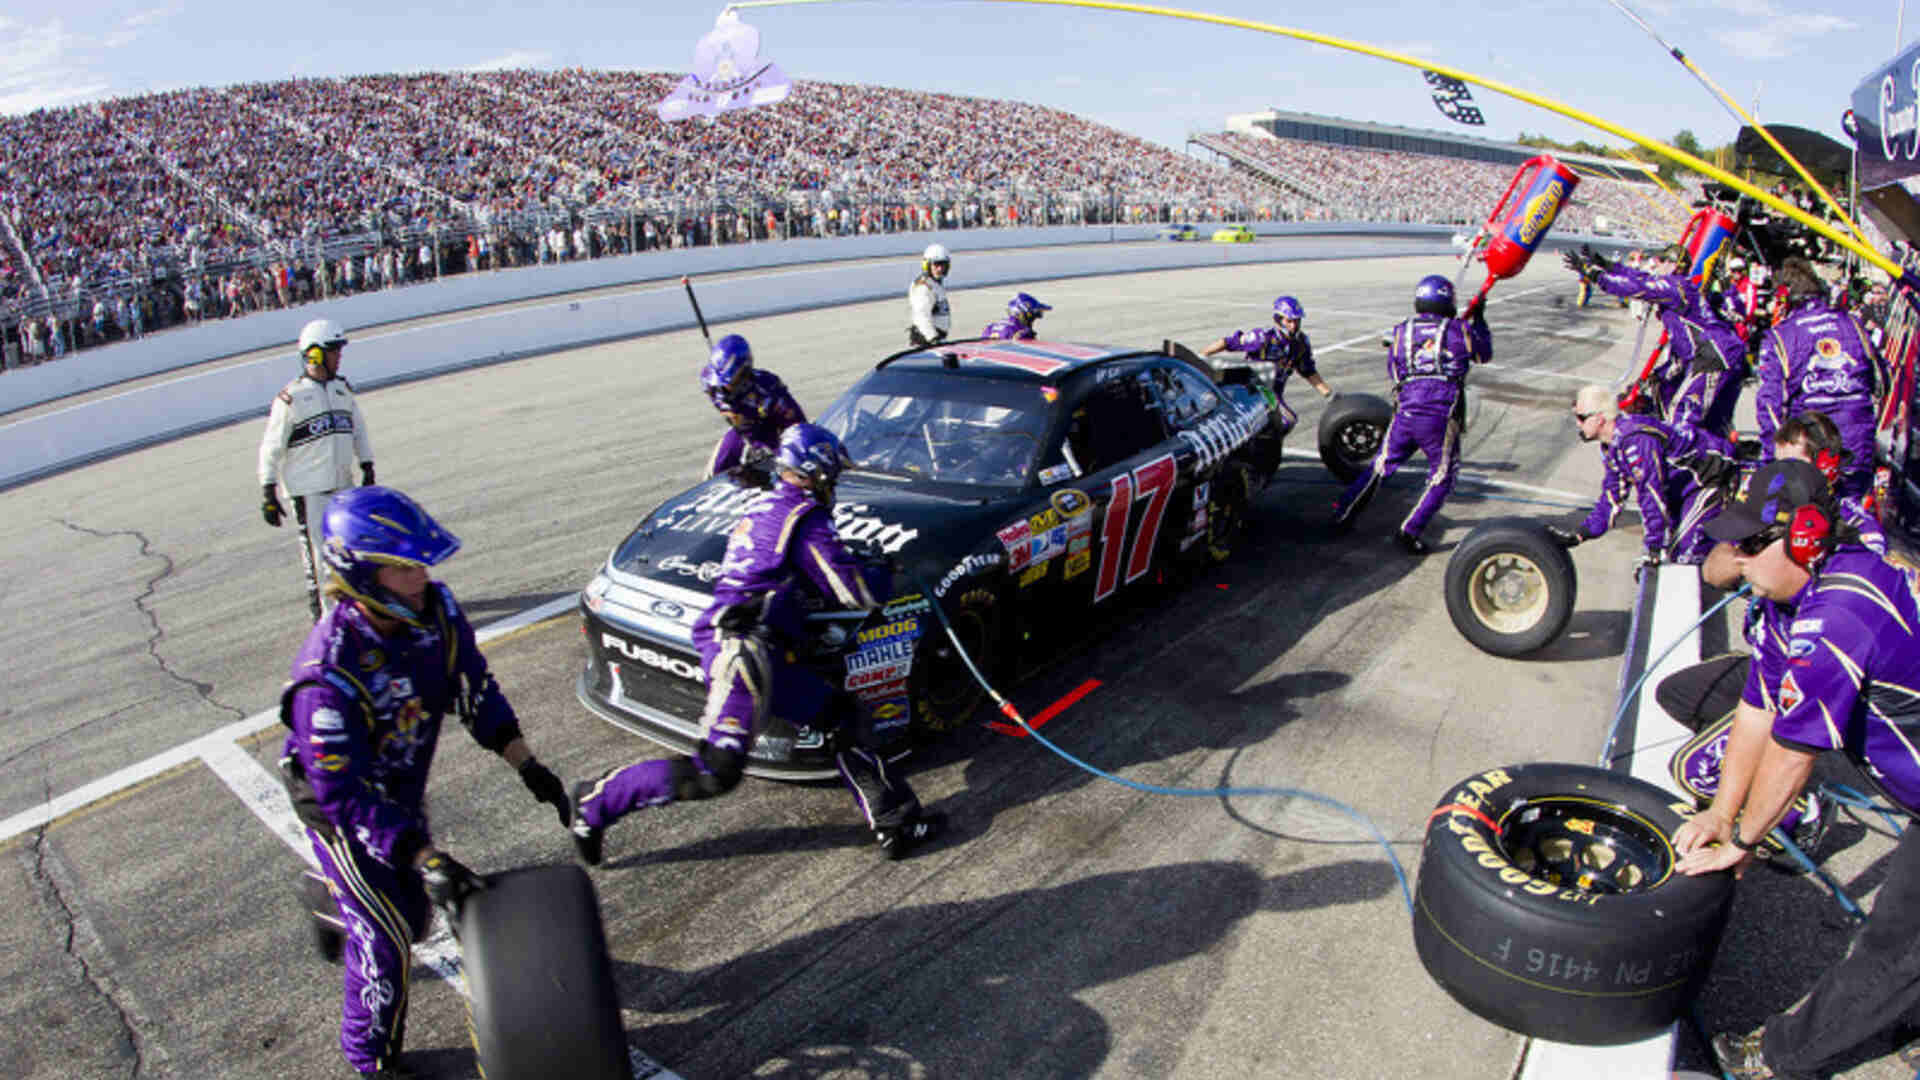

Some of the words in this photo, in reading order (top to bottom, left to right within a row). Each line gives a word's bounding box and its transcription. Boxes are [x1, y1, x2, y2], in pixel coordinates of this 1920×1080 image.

[1094, 452, 1176, 603] 17
[857, 618, 918, 643] MOOG
[848, 640, 913, 671] MAHLE
[1526, 949, 1600, 983] 4416
